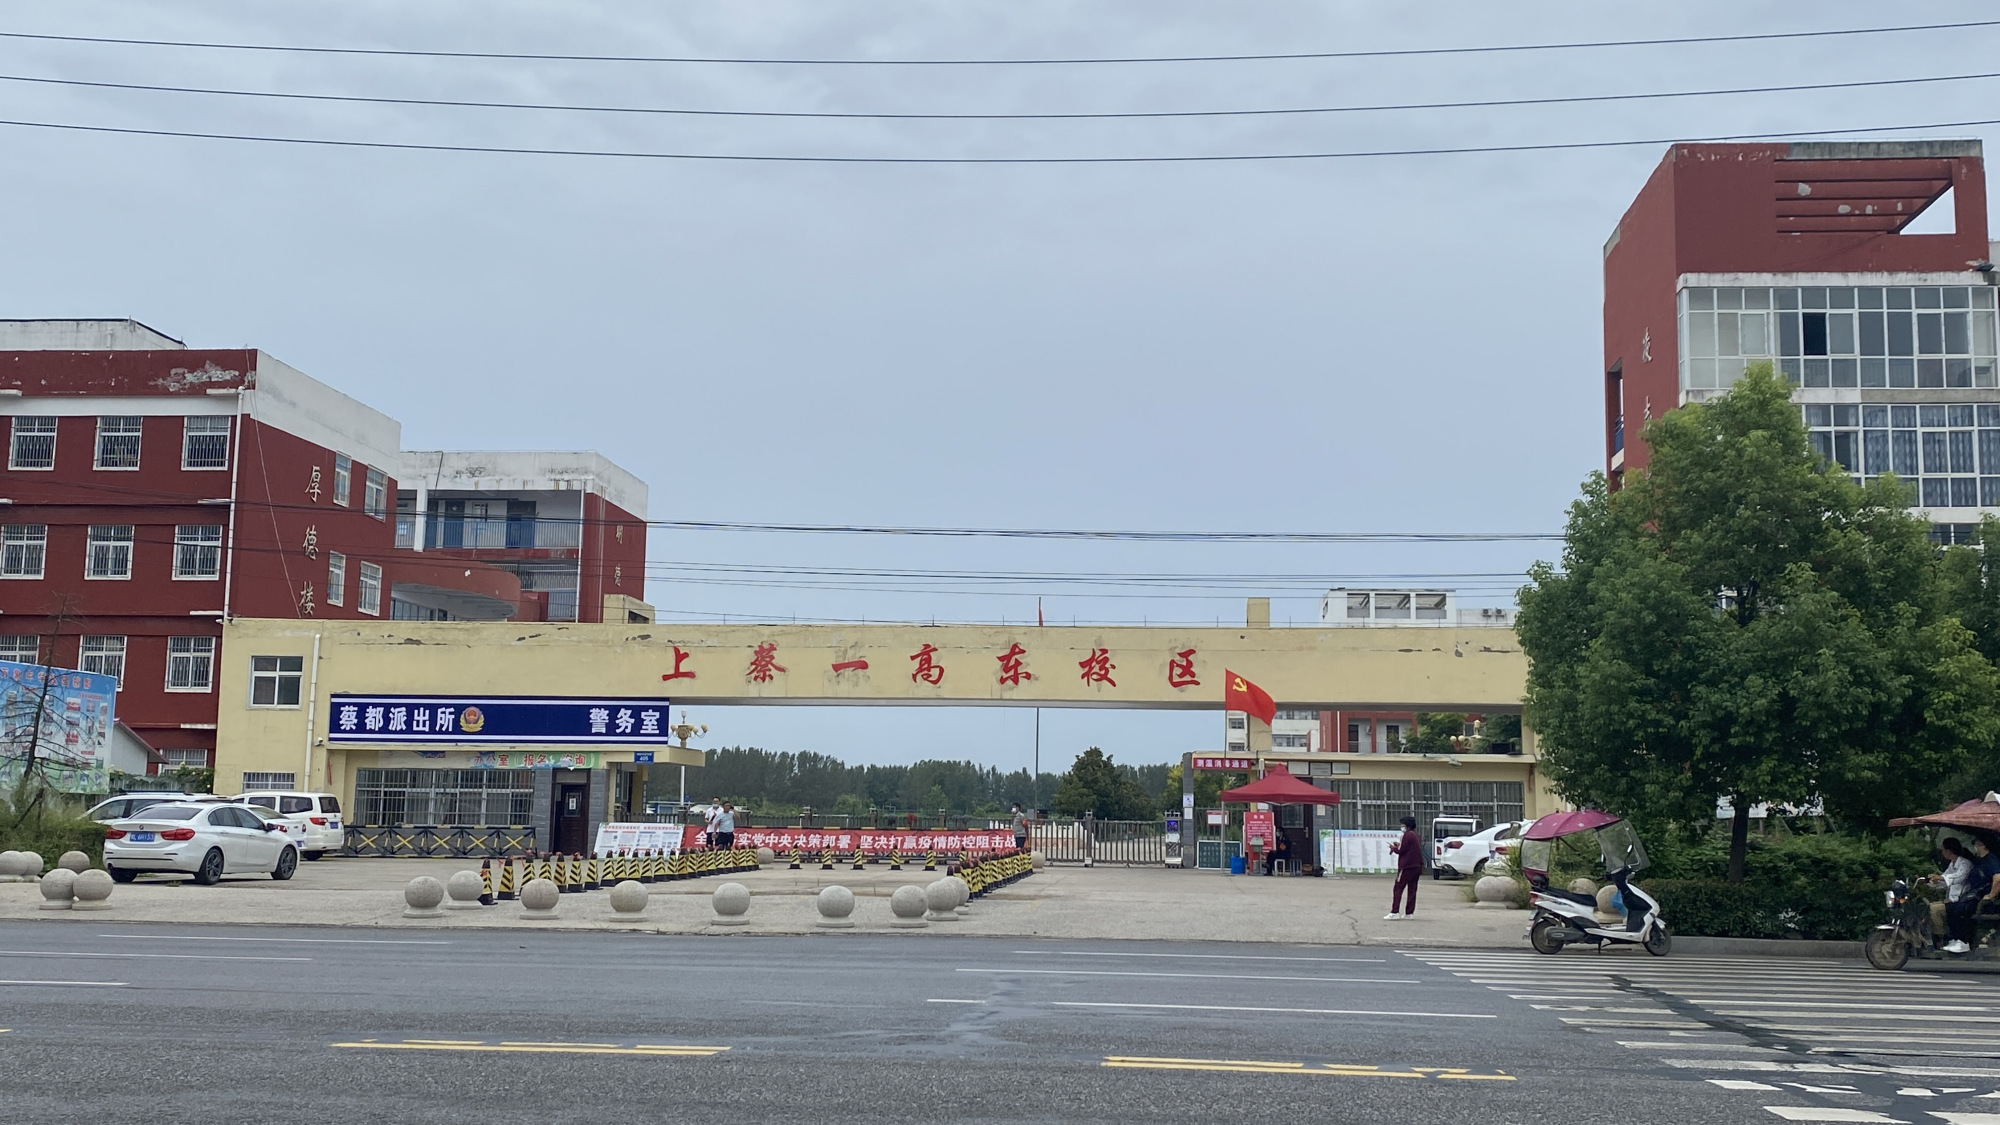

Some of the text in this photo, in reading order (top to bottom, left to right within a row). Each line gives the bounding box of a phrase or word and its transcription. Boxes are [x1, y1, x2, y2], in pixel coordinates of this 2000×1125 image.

[299, 465, 322, 615] 厚德楼
[662, 642, 1201, 688] 上蔡一高东校区
[339, 705, 661, 734] 蔡都派出所 警务室
[694, 830, 851, 849] 全实党中央决策部署
[860, 835, 1017, 849] 坚决打赢疫情防控阻击战
